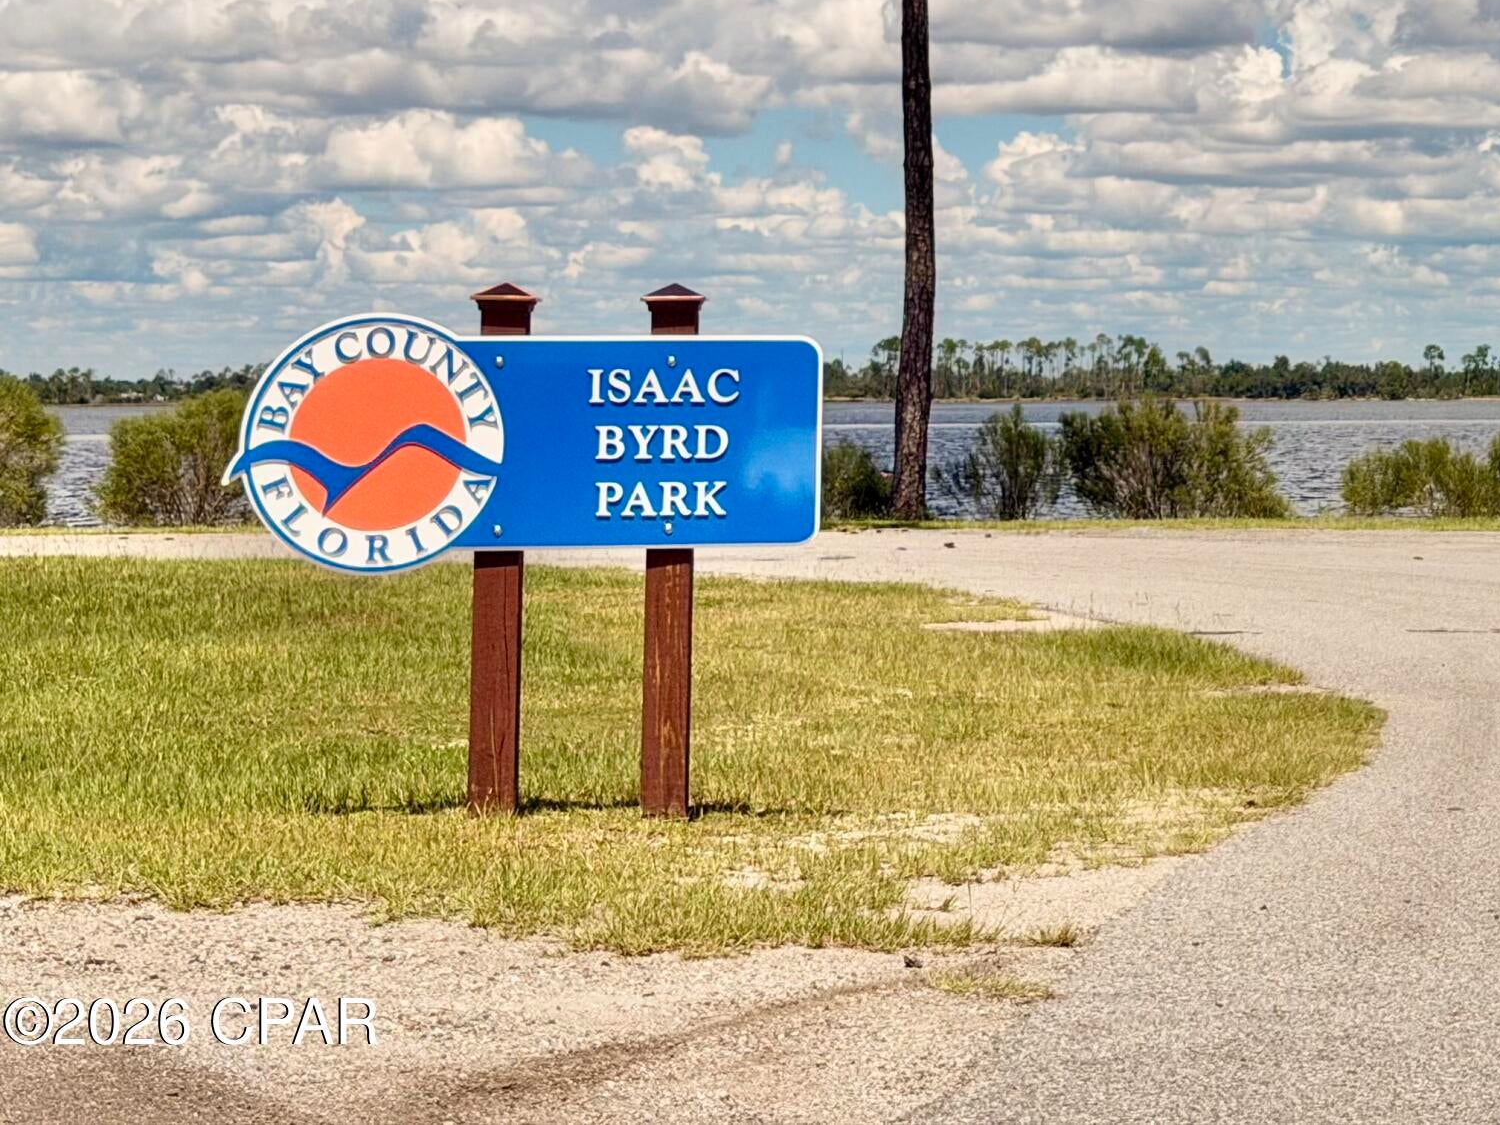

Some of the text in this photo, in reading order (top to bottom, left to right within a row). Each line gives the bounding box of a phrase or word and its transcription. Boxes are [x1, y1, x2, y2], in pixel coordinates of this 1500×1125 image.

[257, 326, 499, 432] BAY COUNTY
[587, 368, 740, 405] ISAAC
[595, 424, 730, 461] BYRD
[596, 481, 728, 518] PARK
[261, 474, 492, 565] FLORIDA
